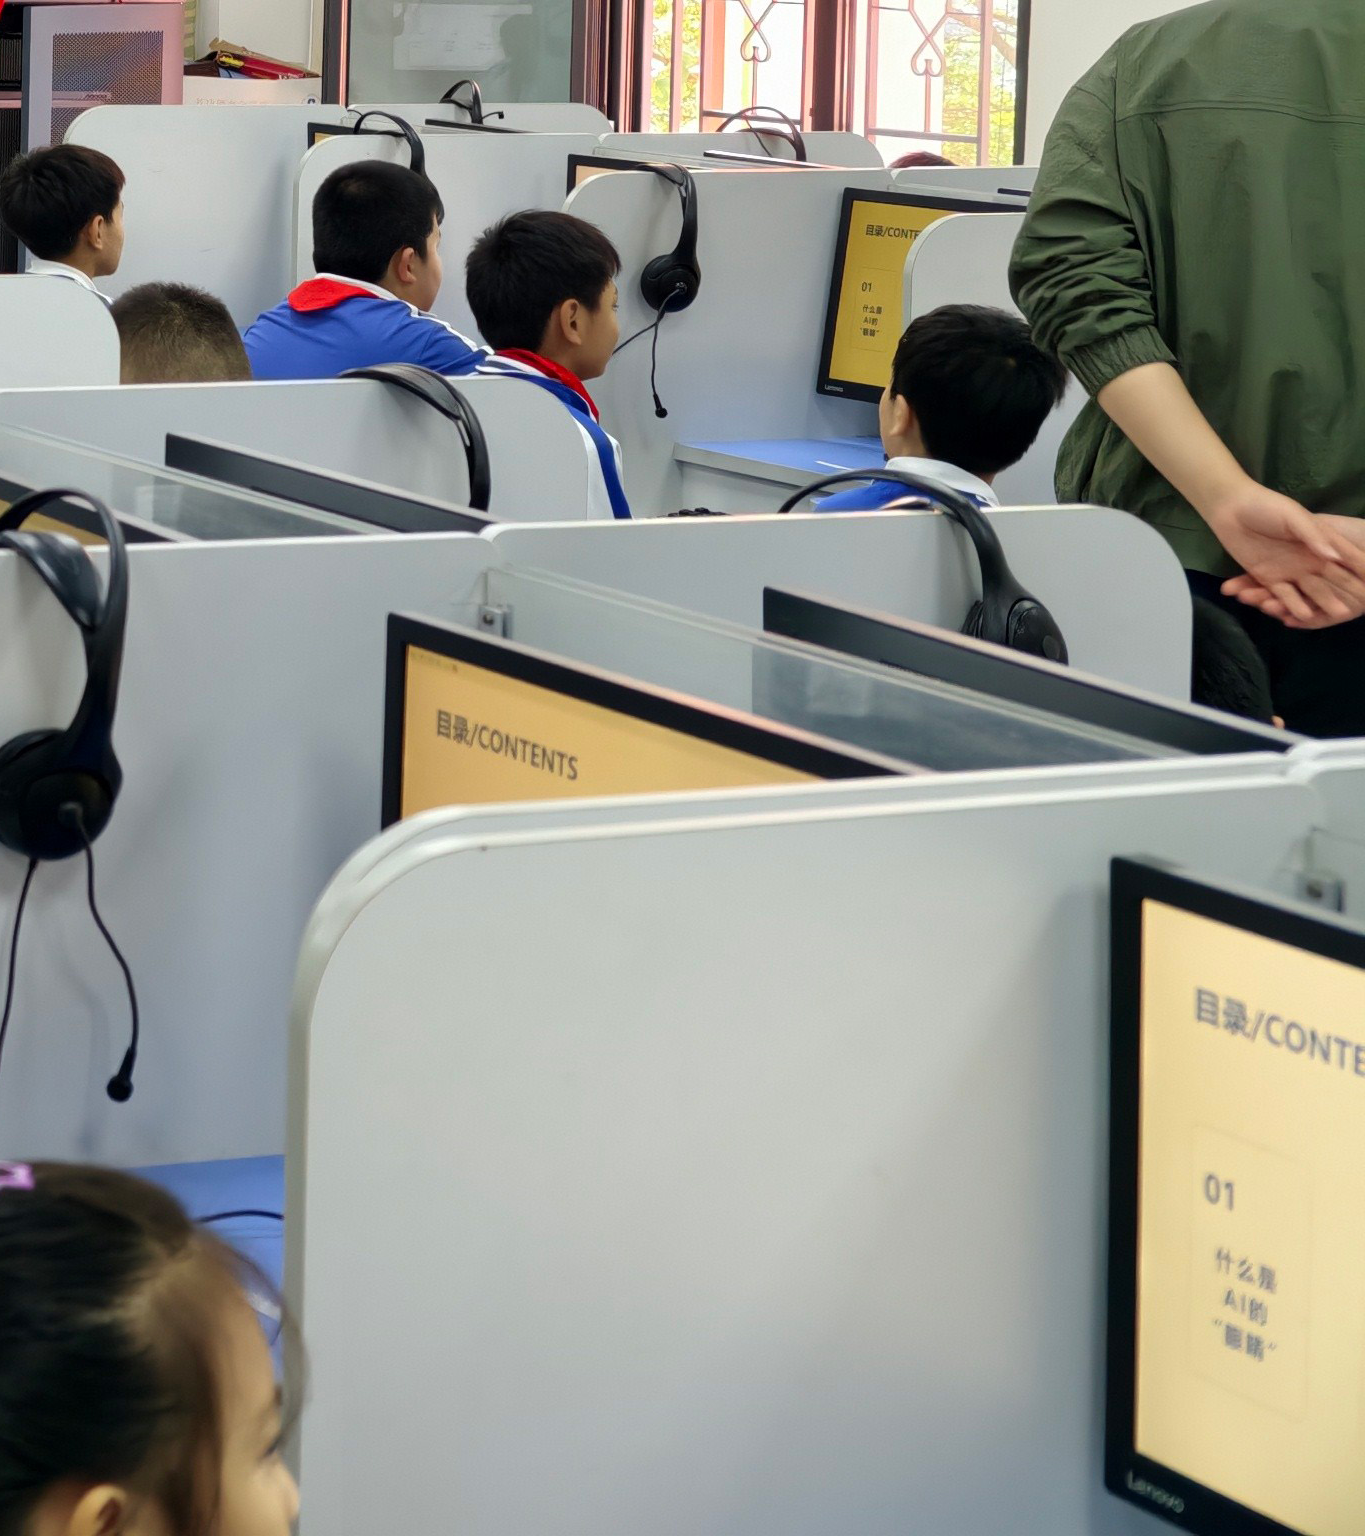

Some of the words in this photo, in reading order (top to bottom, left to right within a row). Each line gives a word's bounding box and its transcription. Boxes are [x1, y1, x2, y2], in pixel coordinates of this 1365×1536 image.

[861, 281, 873, 293] 01
[437, 708, 579, 781] 目录/CONTENTS
[1204, 1172, 1236, 1211] 01
[1126, 1469, 1185, 1514] Lenovo
